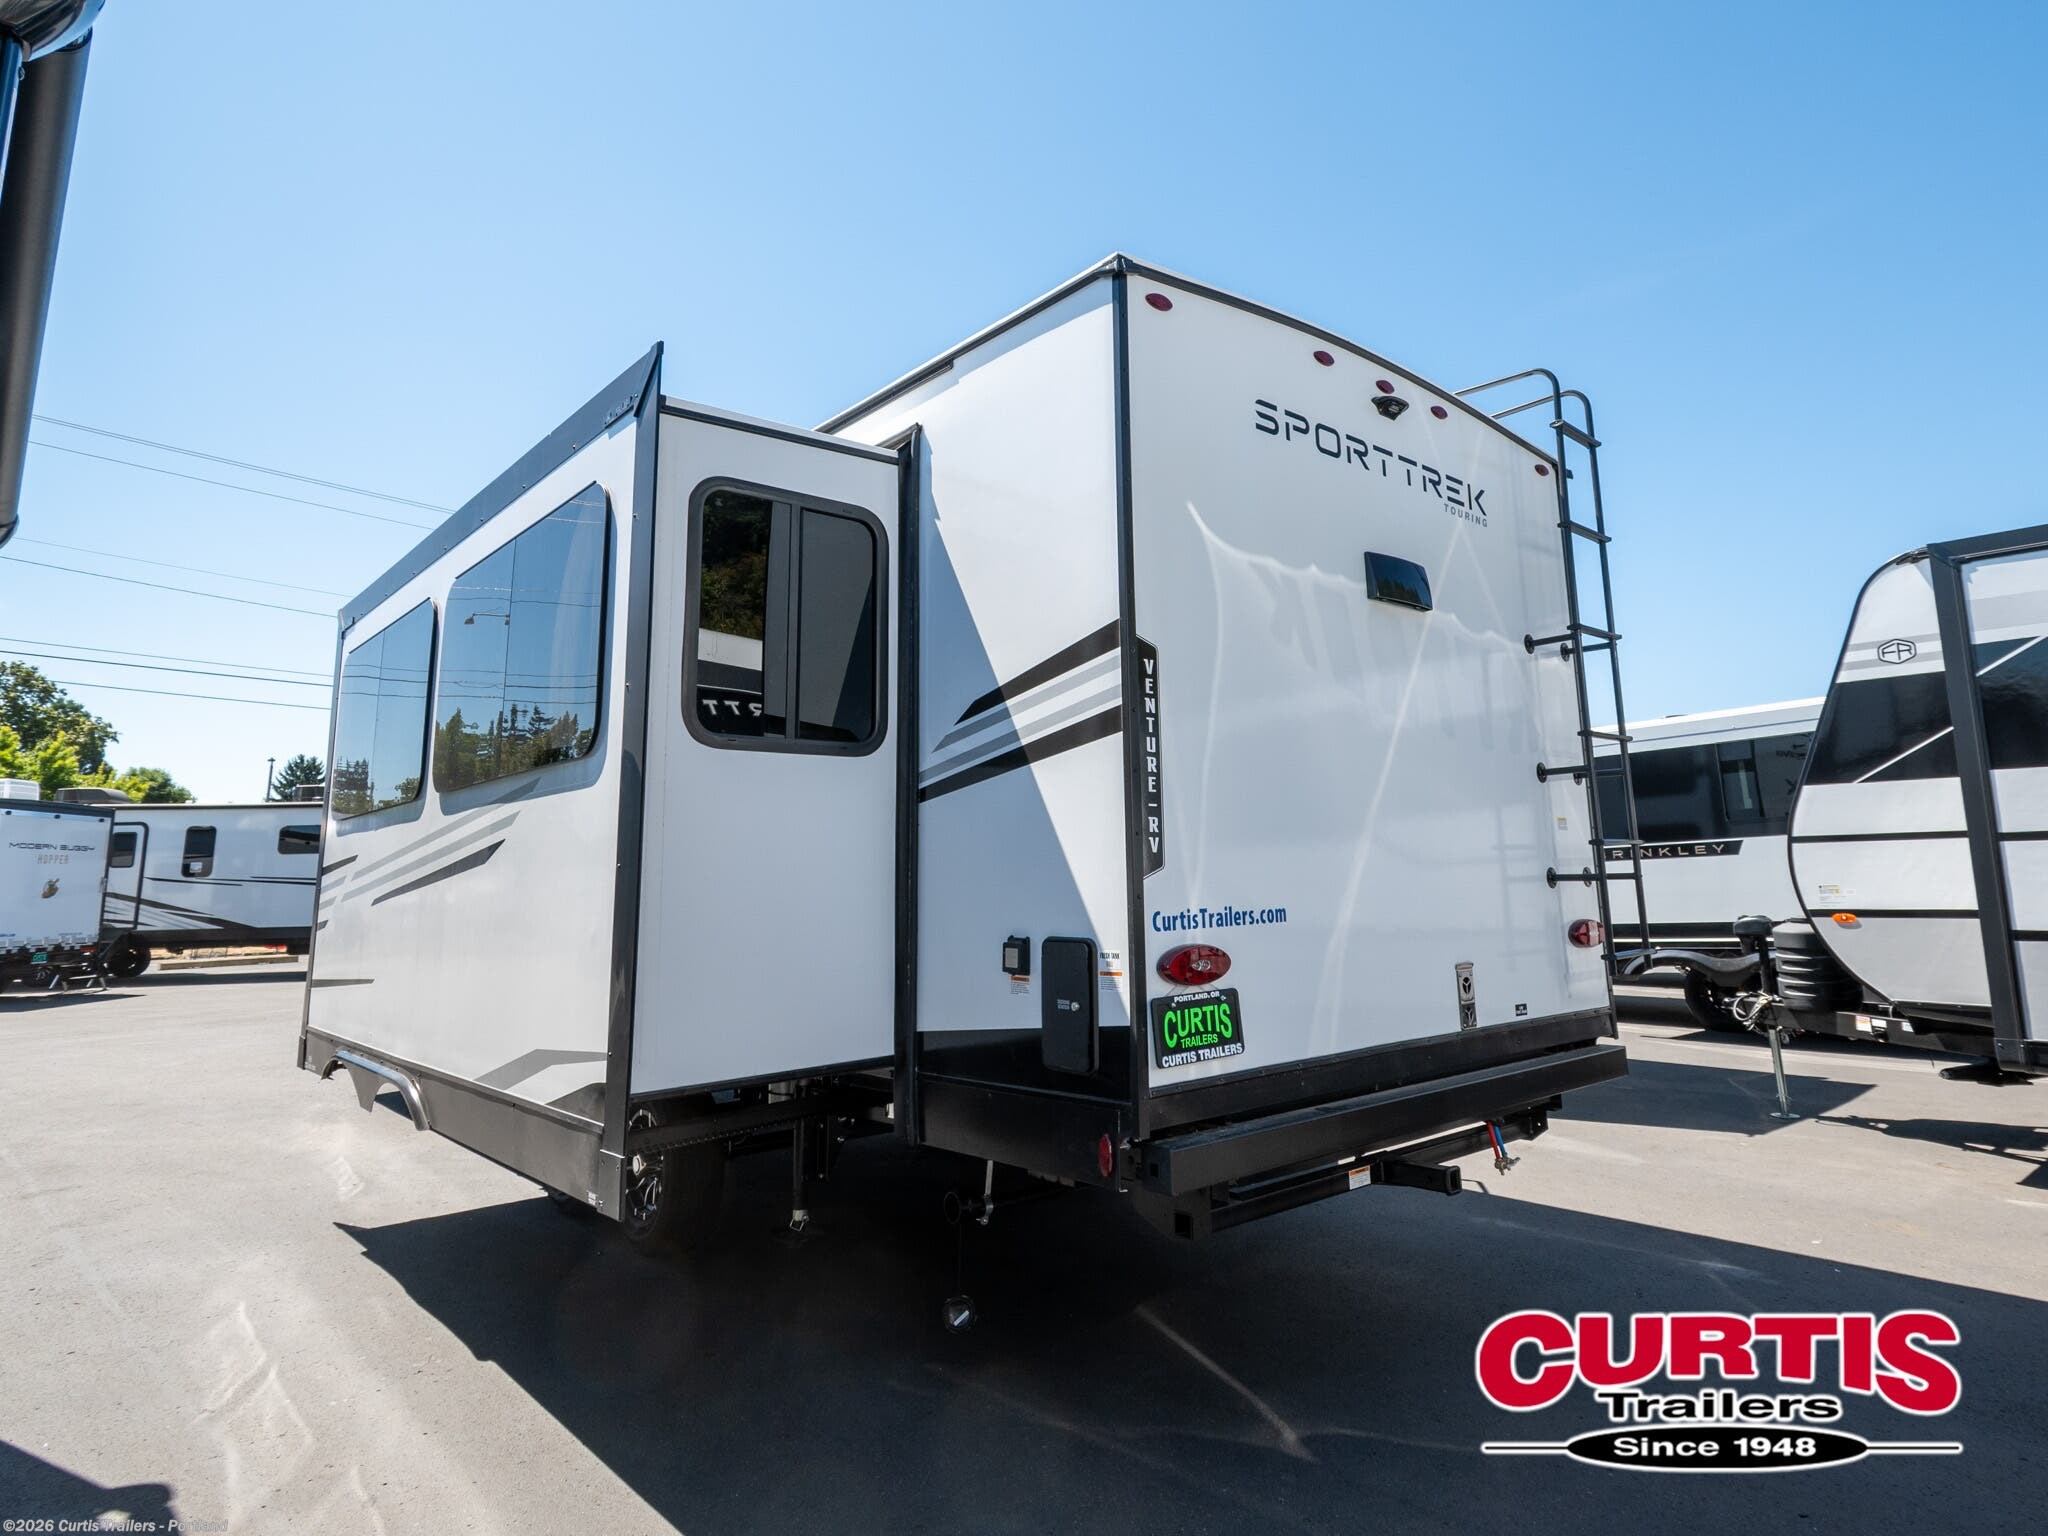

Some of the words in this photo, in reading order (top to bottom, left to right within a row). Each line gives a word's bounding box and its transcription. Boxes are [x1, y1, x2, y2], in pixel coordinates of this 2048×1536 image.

[1255, 399, 1487, 516] SPORTTREK
[1444, 503, 1487, 527] TOURING
[9, 842, 57, 850] MODERN
[1603, 843, 1725, 859] RINKLEY
[37, 854, 69, 864] HOPPER
[1152, 905, 1287, 932] CurtisTrailers.com
[1164, 1003, 1233, 1048] CURTIS
[1180, 1033, 1219, 1049] TRAILERS
[1162, 1051, 1197, 1068] CURTIS
[1198, 1042, 1243, 1061] TRAILERS
